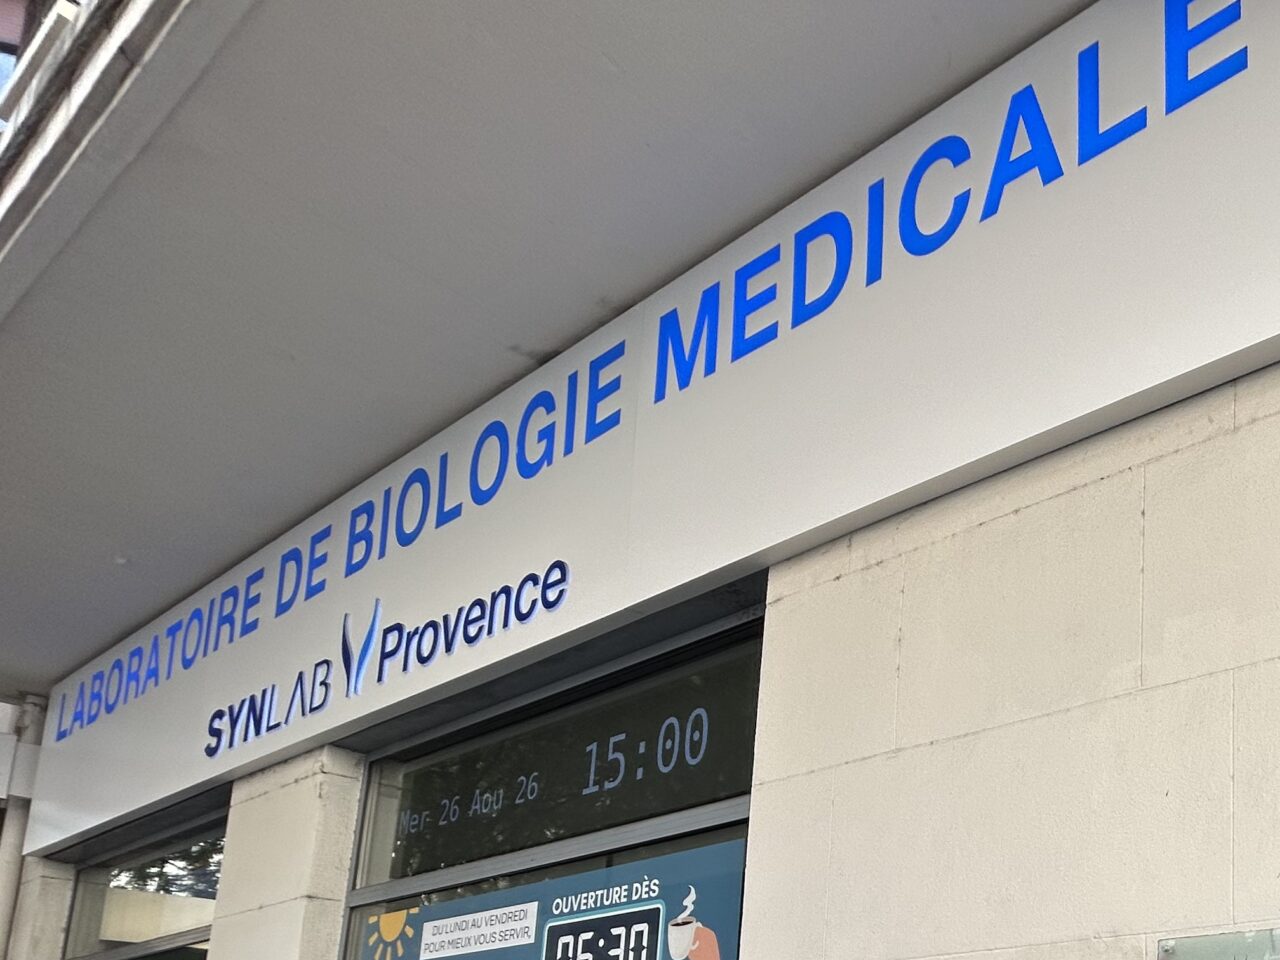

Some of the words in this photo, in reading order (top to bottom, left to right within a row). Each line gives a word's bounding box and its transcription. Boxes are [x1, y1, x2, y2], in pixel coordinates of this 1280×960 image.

[55, 567, 264, 743] LABORATOIRE
[275, 524, 332, 618] DE
[344, 339, 626, 578] BIOLOGIE
[653, 0, 1248, 404] MEDICALE
[205, 657, 333, 758] SYNLAB
[377, 558, 570, 684] Provence
[438, 795, 460, 826] 26
[514, 772, 539, 805] 26
[582, 707, 709, 796] 15:00
[445, 919, 470, 934] LUNDI
[470, 916, 483, 930] AU
[484, 908, 528, 927] VENDREDI
[552, 884, 628, 915] OUVERTURE
[632, 875, 660, 902] DÈS
[424, 941, 445, 954] POUR
[447, 936, 472, 950] MIEUX
[474, 931, 497, 945] VOUS
